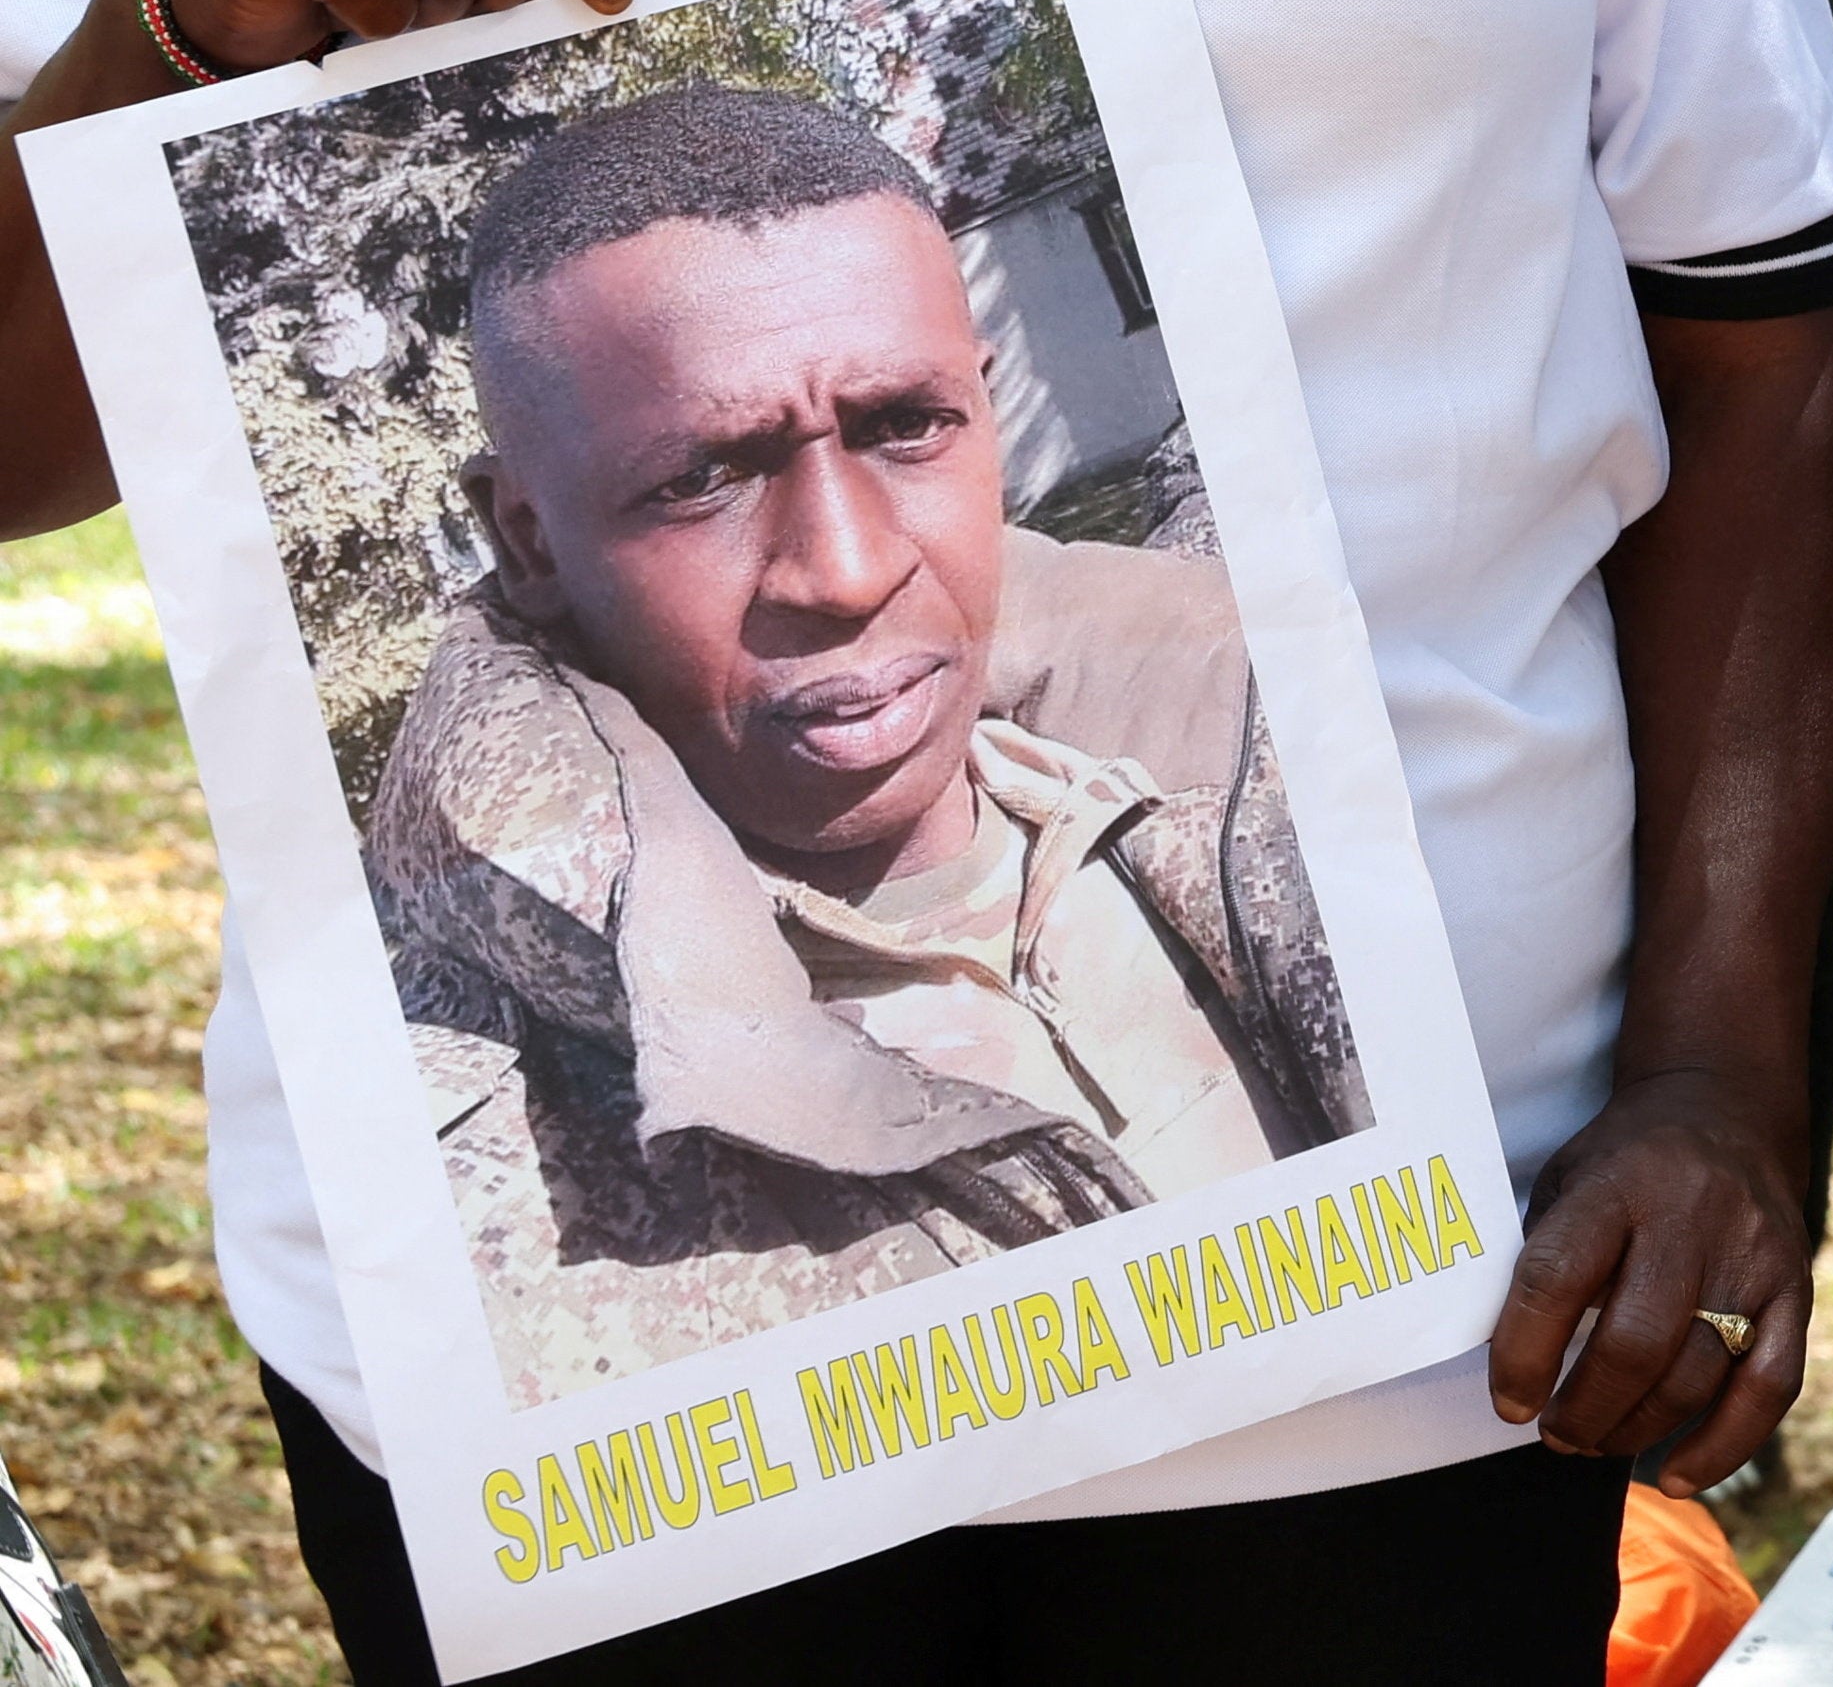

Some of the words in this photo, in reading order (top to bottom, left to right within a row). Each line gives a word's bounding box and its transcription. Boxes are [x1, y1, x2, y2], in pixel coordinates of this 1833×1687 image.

[483, 1389, 797, 1584] SAMUEL
[796, 1278, 1131, 1479] MWAURA
[1124, 1154, 1484, 1367] WAINAINA
